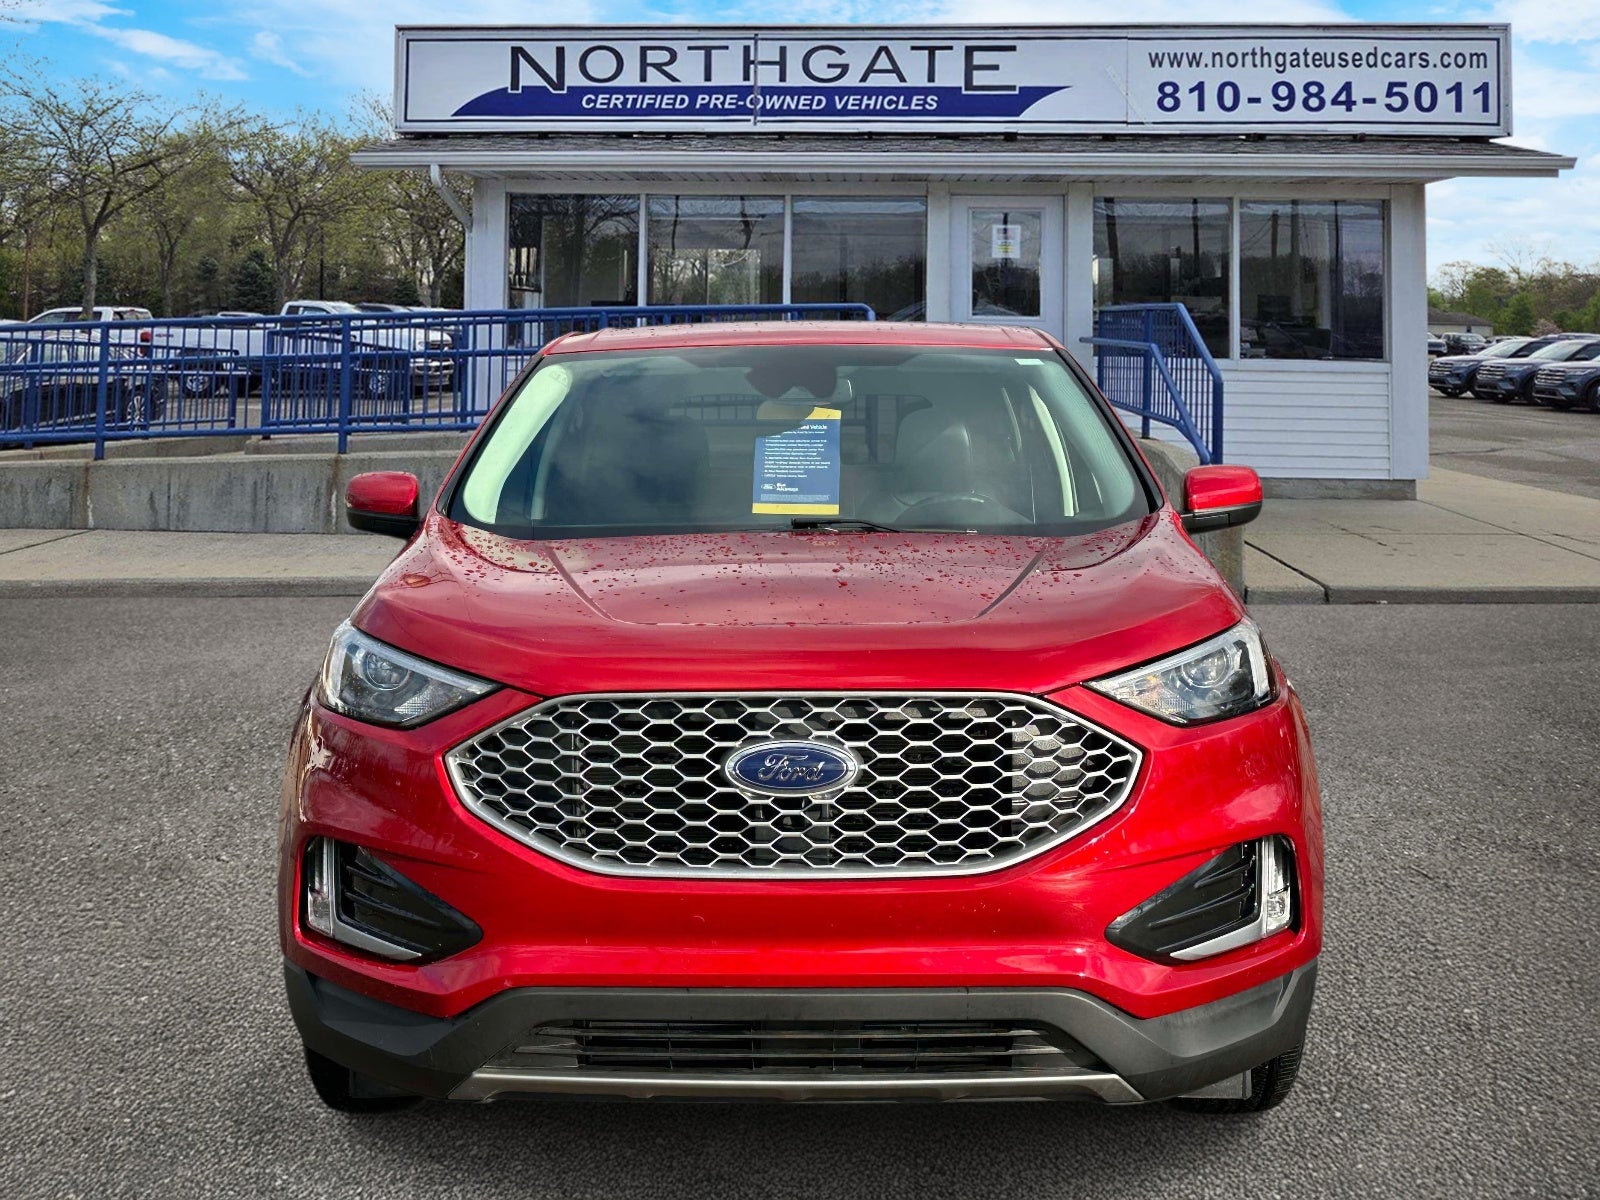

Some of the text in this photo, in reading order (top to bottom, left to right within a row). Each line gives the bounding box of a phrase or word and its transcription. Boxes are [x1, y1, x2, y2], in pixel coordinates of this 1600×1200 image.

[510, 45, 1017, 92] NORTHGATE
[1148, 46, 1488, 73] www.northgateusedcars.com
[581, 94, 938, 110] CERTIFIED PRE-OWNED VEHICLES
[1156, 80, 1490, 113] 810-984-5011
[758, 753, 825, 780] Ford
